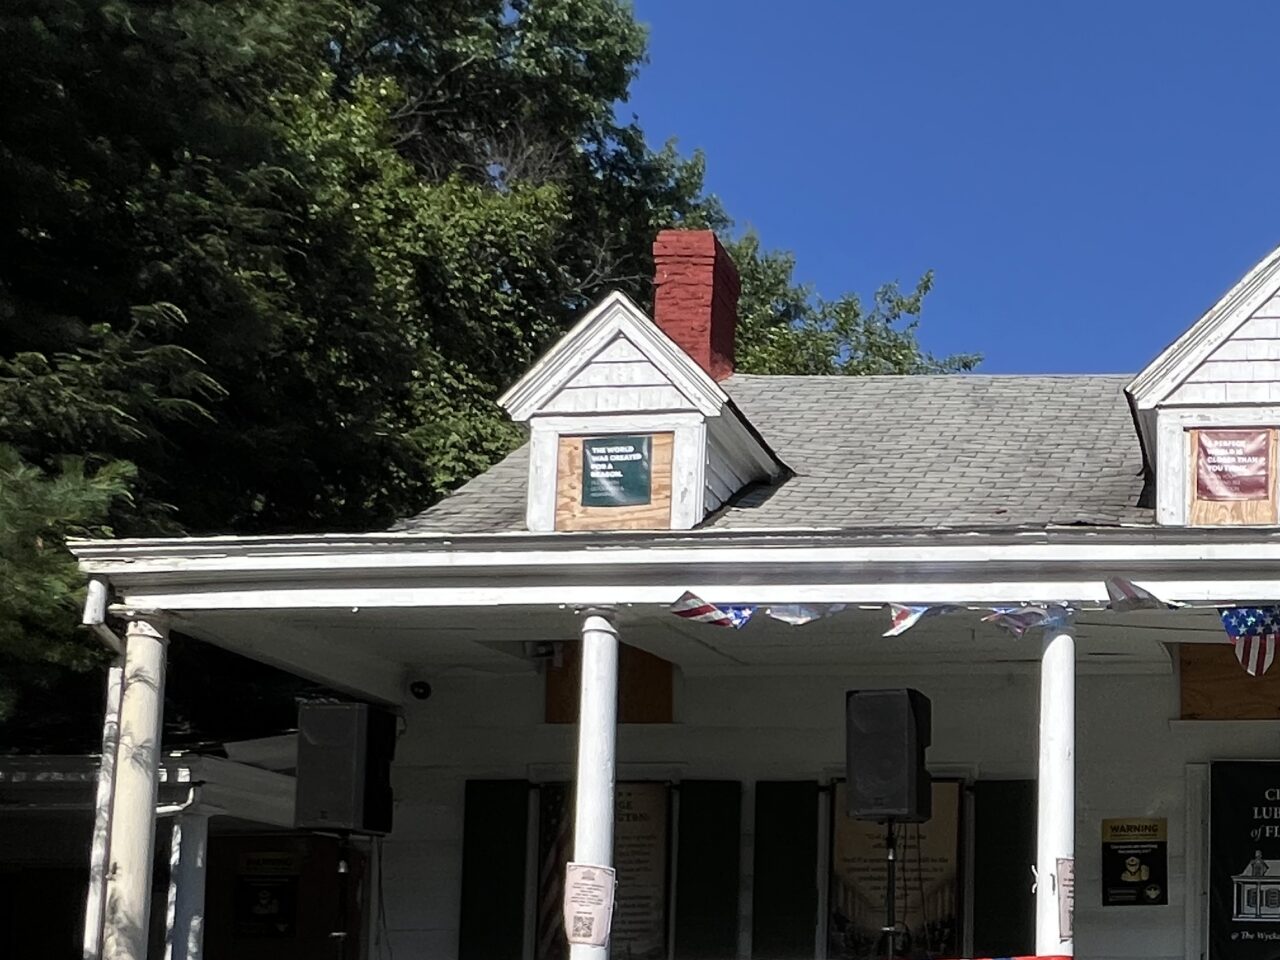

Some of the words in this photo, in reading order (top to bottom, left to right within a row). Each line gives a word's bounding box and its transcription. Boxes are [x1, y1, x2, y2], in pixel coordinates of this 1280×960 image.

[1110, 824, 1158, 832] WARNING
[1250, 825, 1264, 842] of
[1241, 931, 1254, 940] The
